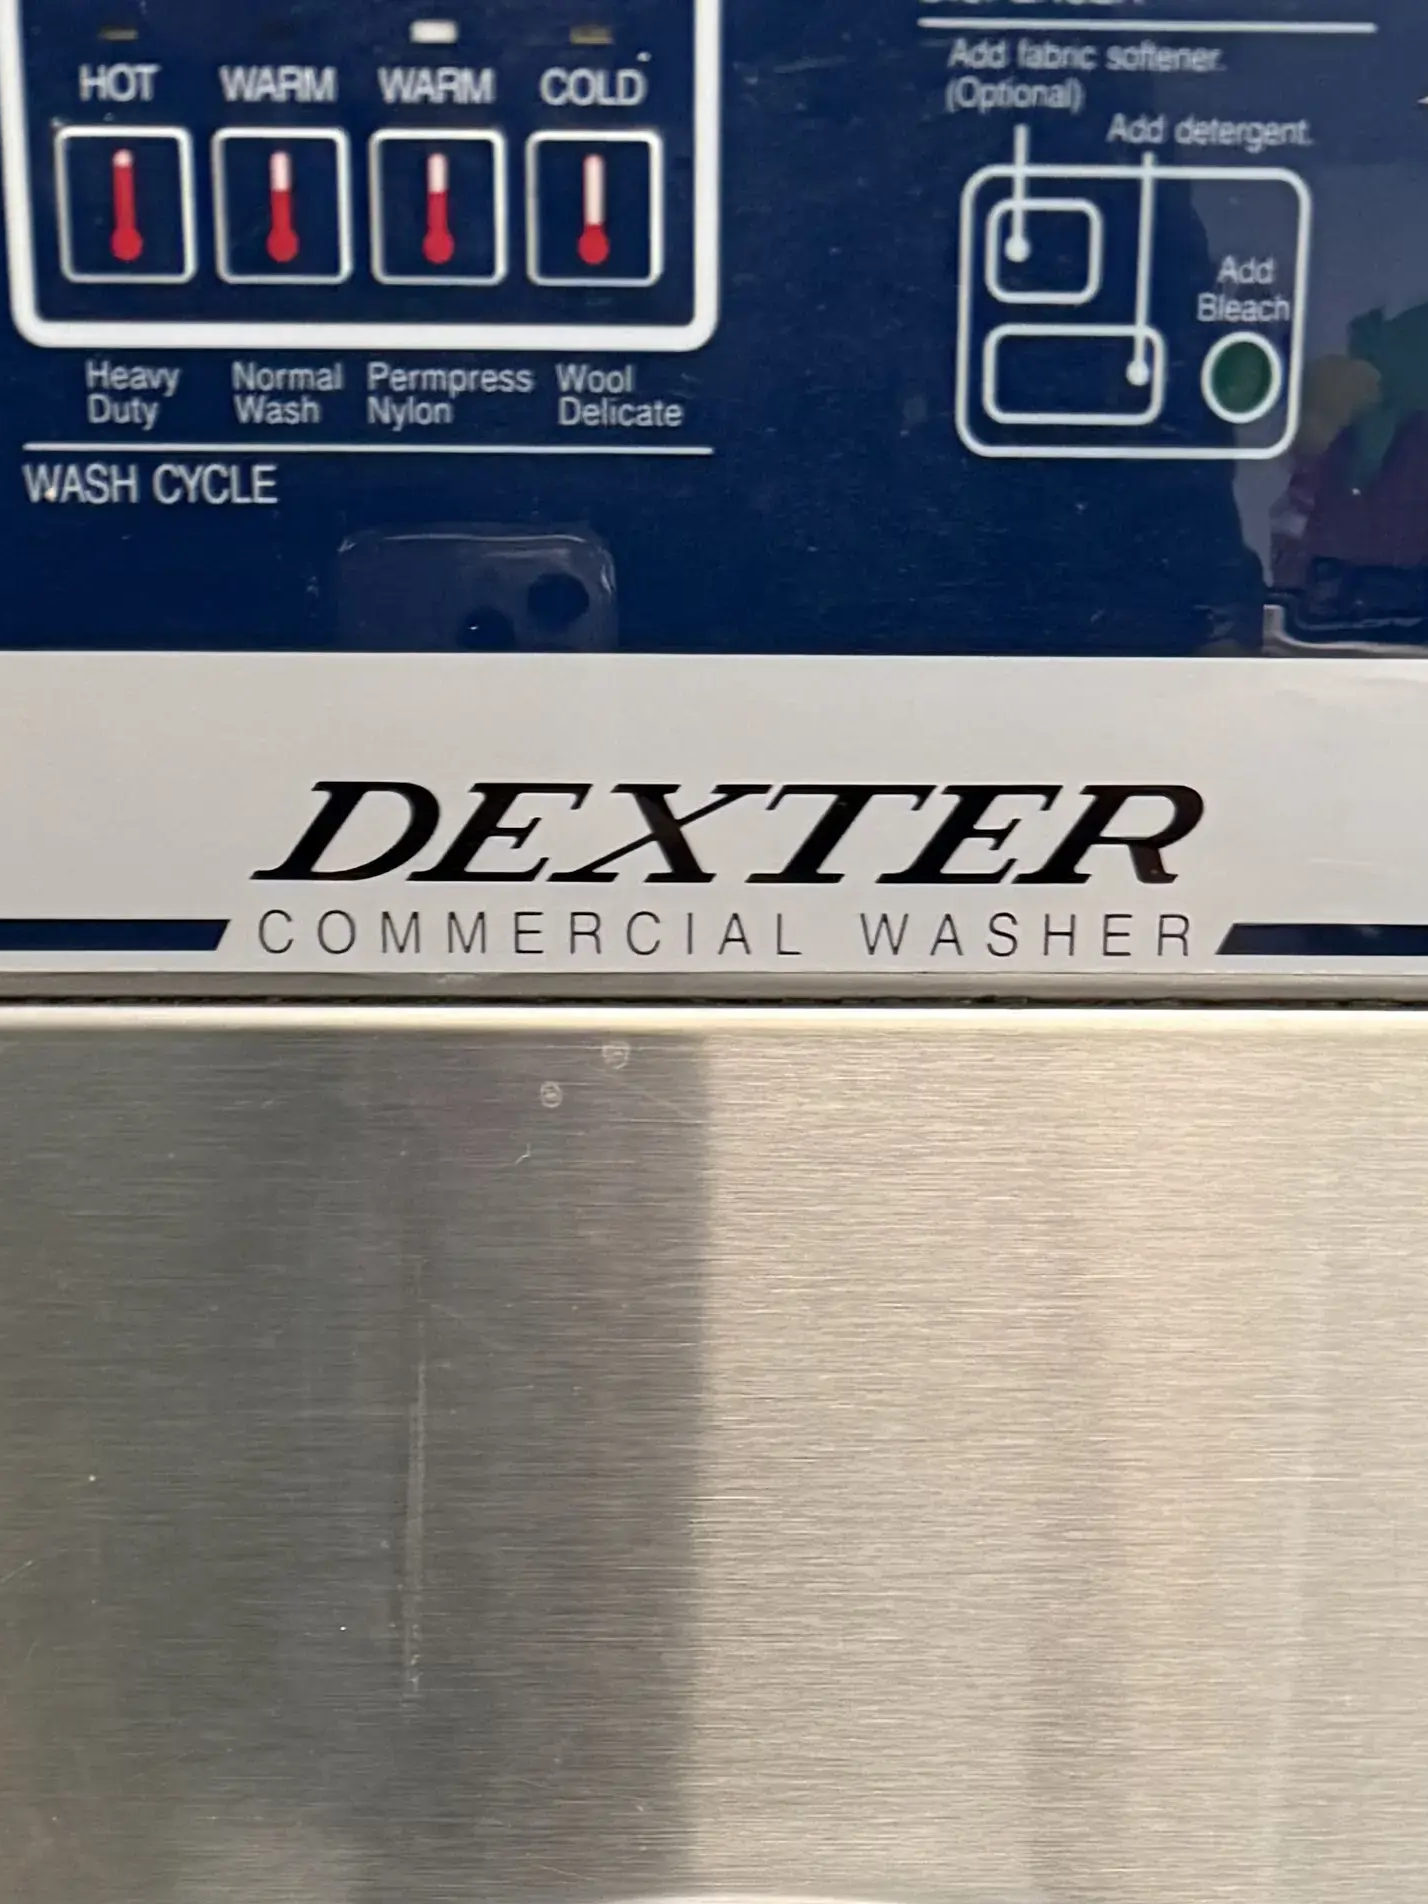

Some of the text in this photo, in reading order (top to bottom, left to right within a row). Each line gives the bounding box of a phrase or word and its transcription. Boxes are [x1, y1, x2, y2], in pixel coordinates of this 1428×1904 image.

[947, 38, 1007, 69] Add
[1017, 39, 1097, 70] fabric
[79, 64, 159, 102] HOT
[221, 65, 337, 103] WARM
[380, 66, 494, 104] WARM
[541, 68, 644, 106] COLD
[946, 77, 1085, 114] (Optional)
[1107, 113, 1164, 145] Add
[1218, 256, 1274, 284] Add
[1197, 294, 1290, 323] Bleach
[86, 361, 181, 397] Heavy
[233, 361, 344, 392] Normal
[367, 362, 533, 401] Permpress
[556, 364, 633, 394] Wool
[87, 394, 159, 431] Duty
[234, 396, 321, 426] Wash
[368, 396, 454, 433] Nylon
[558, 397, 683, 428] Delicate
[23, 465, 279, 505] WASH CYCLE
[251, 779, 1206, 885] DEXTER
[257, 908, 1193, 958] COMMERCIAL WASHER
